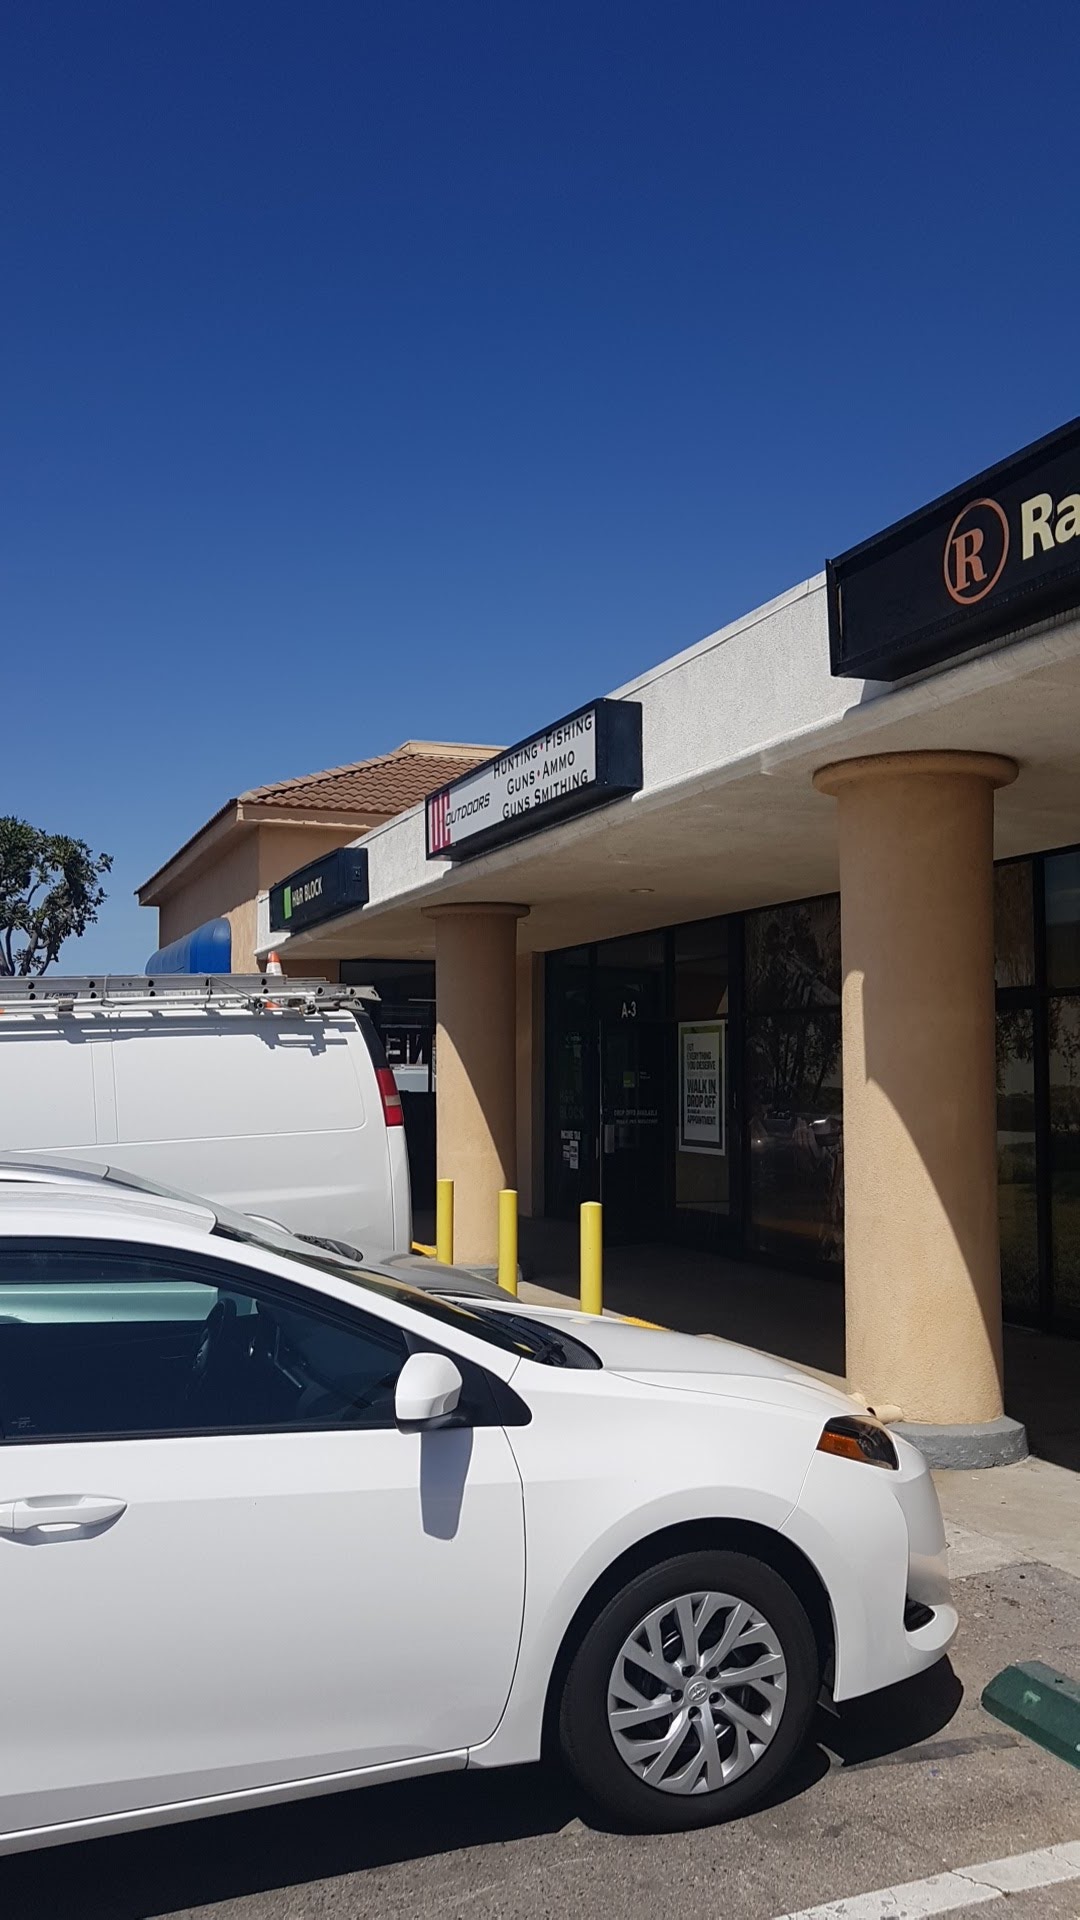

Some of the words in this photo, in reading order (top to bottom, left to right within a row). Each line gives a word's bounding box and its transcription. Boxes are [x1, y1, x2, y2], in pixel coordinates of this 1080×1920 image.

[1021, 493, 1080, 560] Ra
[493, 744, 538, 779] HUNTING
[545, 714, 593, 752] FISHING
[507, 770, 535, 795] GUNS
[542, 750, 575, 779] AMMO
[445, 792, 490, 827] OUTDOORS
[502, 796, 530, 819] GUNS
[534, 769, 588, 806] SMITHING
[304, 876, 323, 902] BLOCK
[697, 1060, 716, 1070] DESERVE
[687, 1078, 707, 1094] WALK
[687, 1094, 703, 1108] DROP
[704, 1095, 716, 1109] OFF
